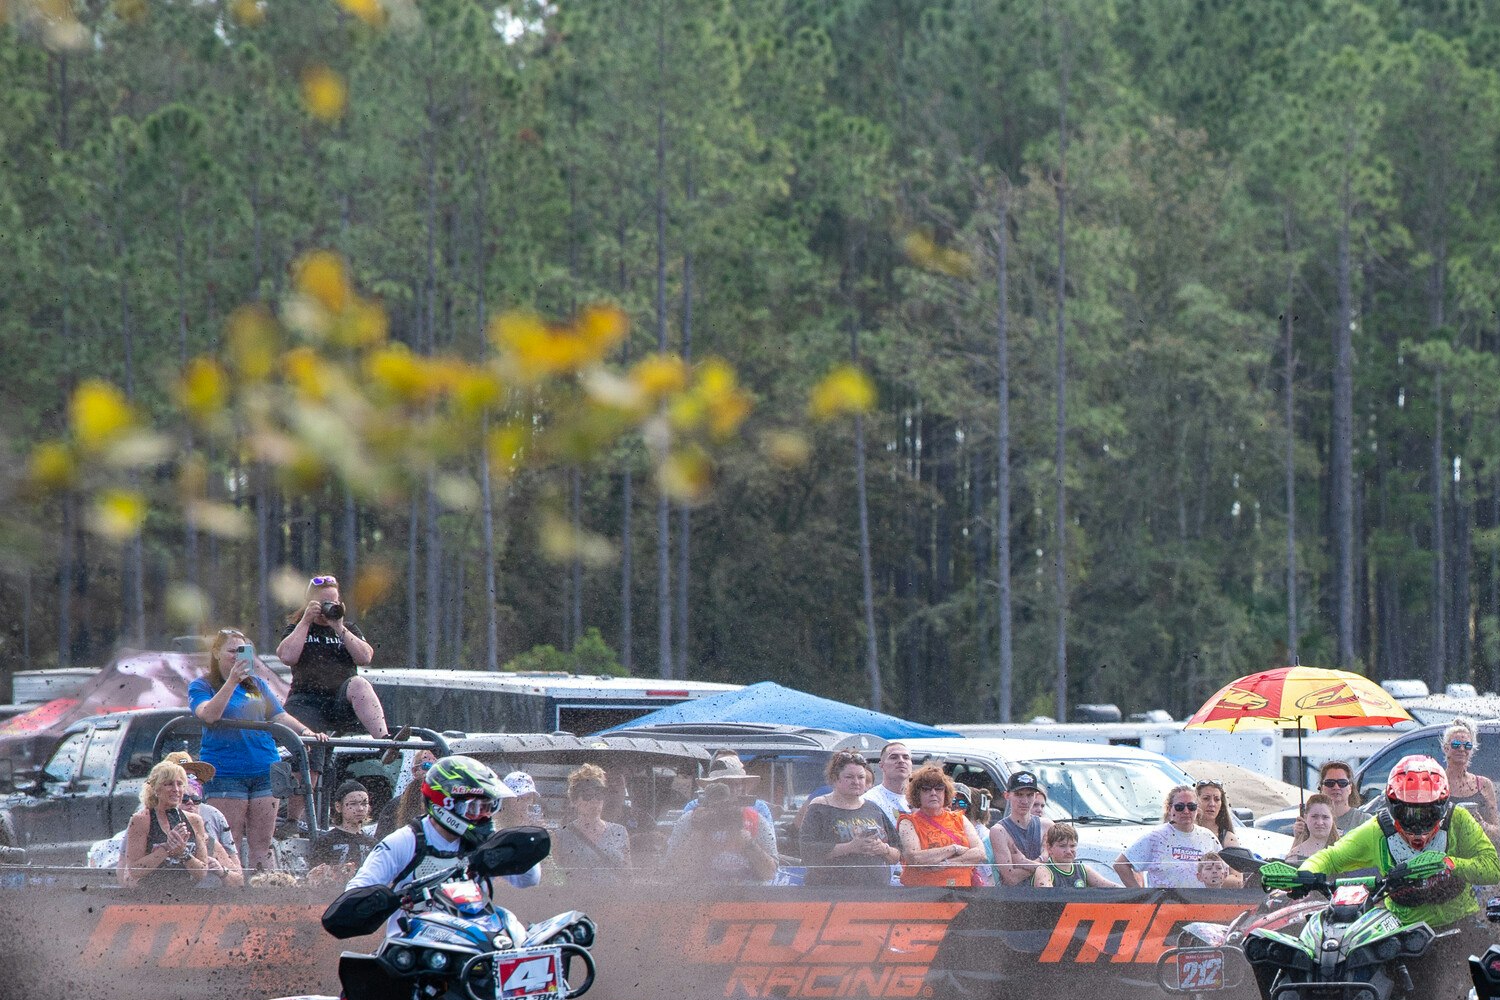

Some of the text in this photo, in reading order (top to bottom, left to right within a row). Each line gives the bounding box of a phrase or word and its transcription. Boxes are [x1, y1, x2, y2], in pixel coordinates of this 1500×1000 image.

[503, 956, 554, 993] 4
[724, 965, 926, 998] RACING
[1181, 958, 1221, 988] 212
